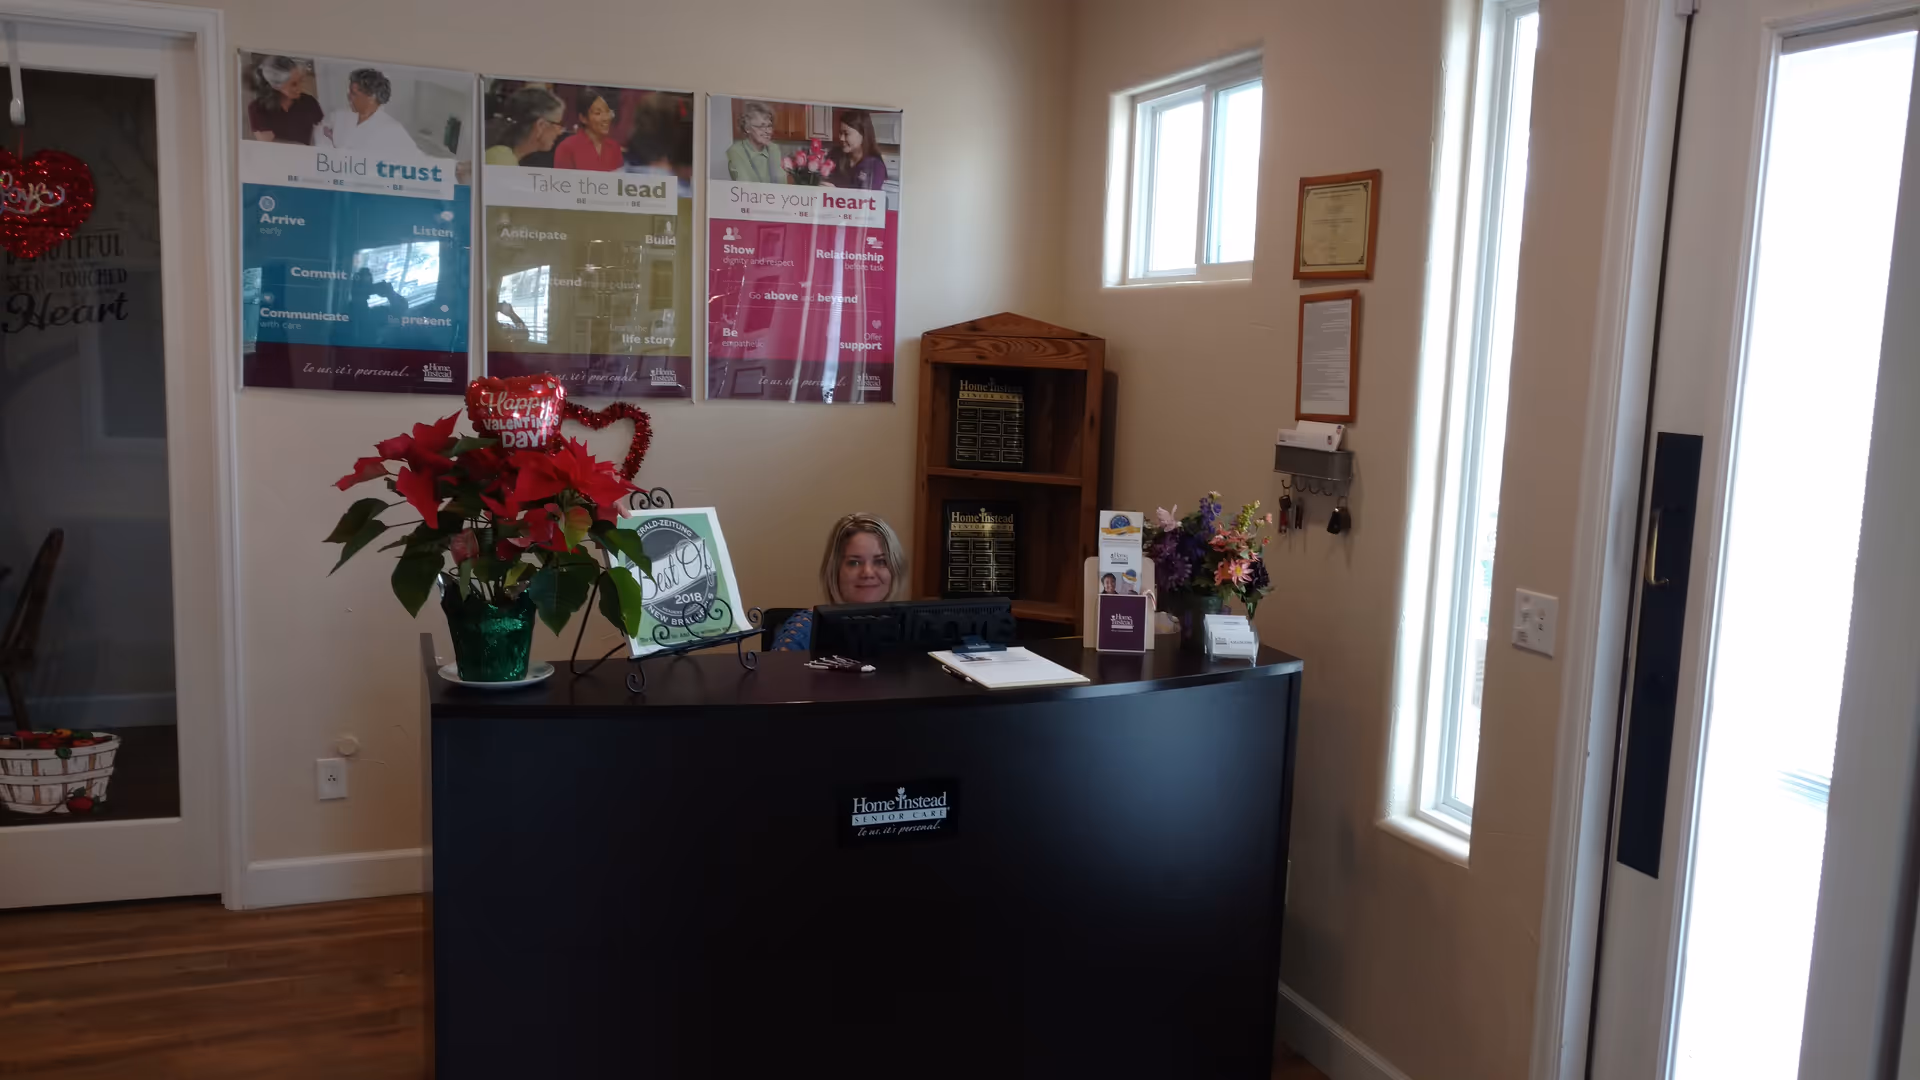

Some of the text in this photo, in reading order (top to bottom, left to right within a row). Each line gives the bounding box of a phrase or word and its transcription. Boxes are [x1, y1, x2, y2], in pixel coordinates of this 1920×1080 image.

[316, 153, 442, 182] Build trust
[528, 174, 666, 198] Take the lead
[731, 187, 876, 211] Share your heart
[260, 214, 305, 226] Arrive
[260, 227, 282, 236] early
[413, 225, 453, 237] Listen
[500, 228, 567, 241] Anticipate
[645, 235, 676, 245] Build
[723, 245, 755, 254] Show
[723, 257, 747, 266] dignity
[767, 259, 794, 268] respect
[816, 250, 884, 263] Relationship
[845, 263, 868, 271] before
[291, 267, 347, 280] Commit
[749, 292, 761, 300] Go
[764, 292, 798, 301] above
[818, 293, 858, 304] beyond
[2, 292, 129, 333] Heart
[260, 308, 349, 322] Communicate
[260, 321, 279, 329] with
[401, 316, 452, 327] present
[723, 328, 738, 337] Be
[864, 333, 882, 341] Offer
[622, 334, 676, 347] life story
[840, 342, 882, 351] support
[429, 363, 450, 371] Home
[424, 370, 452, 378] Instead
[960, 380, 987, 391] Home
[480, 391, 552, 420] Happy
[952, 512, 1013, 523] Home Instead
[637, 519, 693, 538] ERALD-ZEITUNG
[675, 592, 702, 604] 2018
[648, 606, 668, 623] NEW
[852, 791, 946, 813] Home Instead
[855, 810, 943, 824] SENIOR CARE
